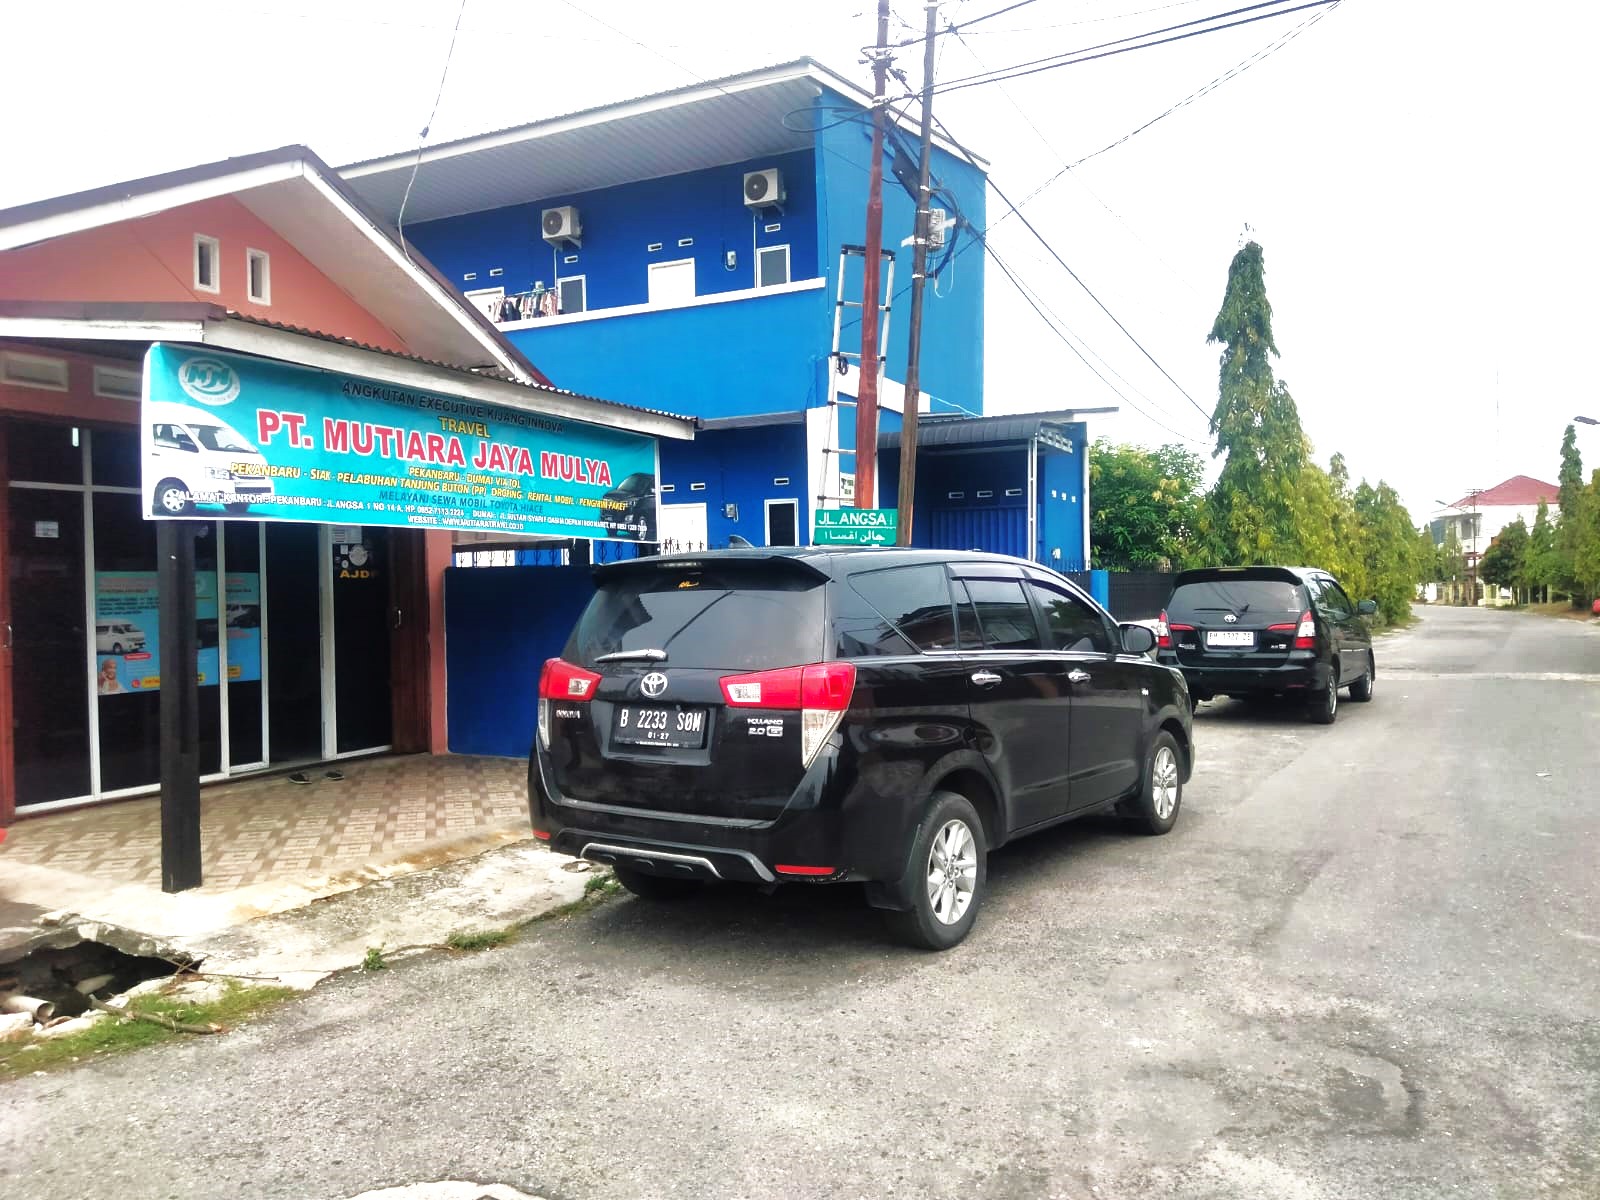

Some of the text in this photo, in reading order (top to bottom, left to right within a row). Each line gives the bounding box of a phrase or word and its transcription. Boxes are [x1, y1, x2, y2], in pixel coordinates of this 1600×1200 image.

[342, 381, 564, 433] ANGKUTAN EXECUTIVE KIJANG INNOVA
[438, 416, 491, 438] TRAVEL
[257, 408, 613, 488] PT. MUTIARA JAYA MULYA
[231, 462, 301, 478] PEKANBARU
[310, 468, 331, 481] SIAK
[337, 472, 397, 487] PELABUHAN
[400, 478, 440, 491] TANJUNG
[442, 483, 468, 494] BUTON
[471, 485, 486, 497] (PP)
[528, 491, 552, 503] RENTAL
[555, 495, 574, 505] MOBIL
[409, 466, 460, 481] PEKANBARU
[466, 473, 493, 485] DUMAI
[495, 476, 507, 486] VIA
[509, 478, 521, 488] TOL
[180, 491, 221, 503] ALAMAT
[223, 493, 263, 504] KANTOR
[270, 495, 322, 507] PEKANBARU
[380, 490, 543, 514] MELAYANI SEWA MOBIL TOYOTA HIACE
[408, 514, 438, 525] WEBSITE
[818, 512, 838, 525] JL.
[838, 512, 887, 526] ANGSA
[620, 709, 629, 728] B
[637, 710, 668, 729] 2233
[647, 731, 670, 740] 01-27
